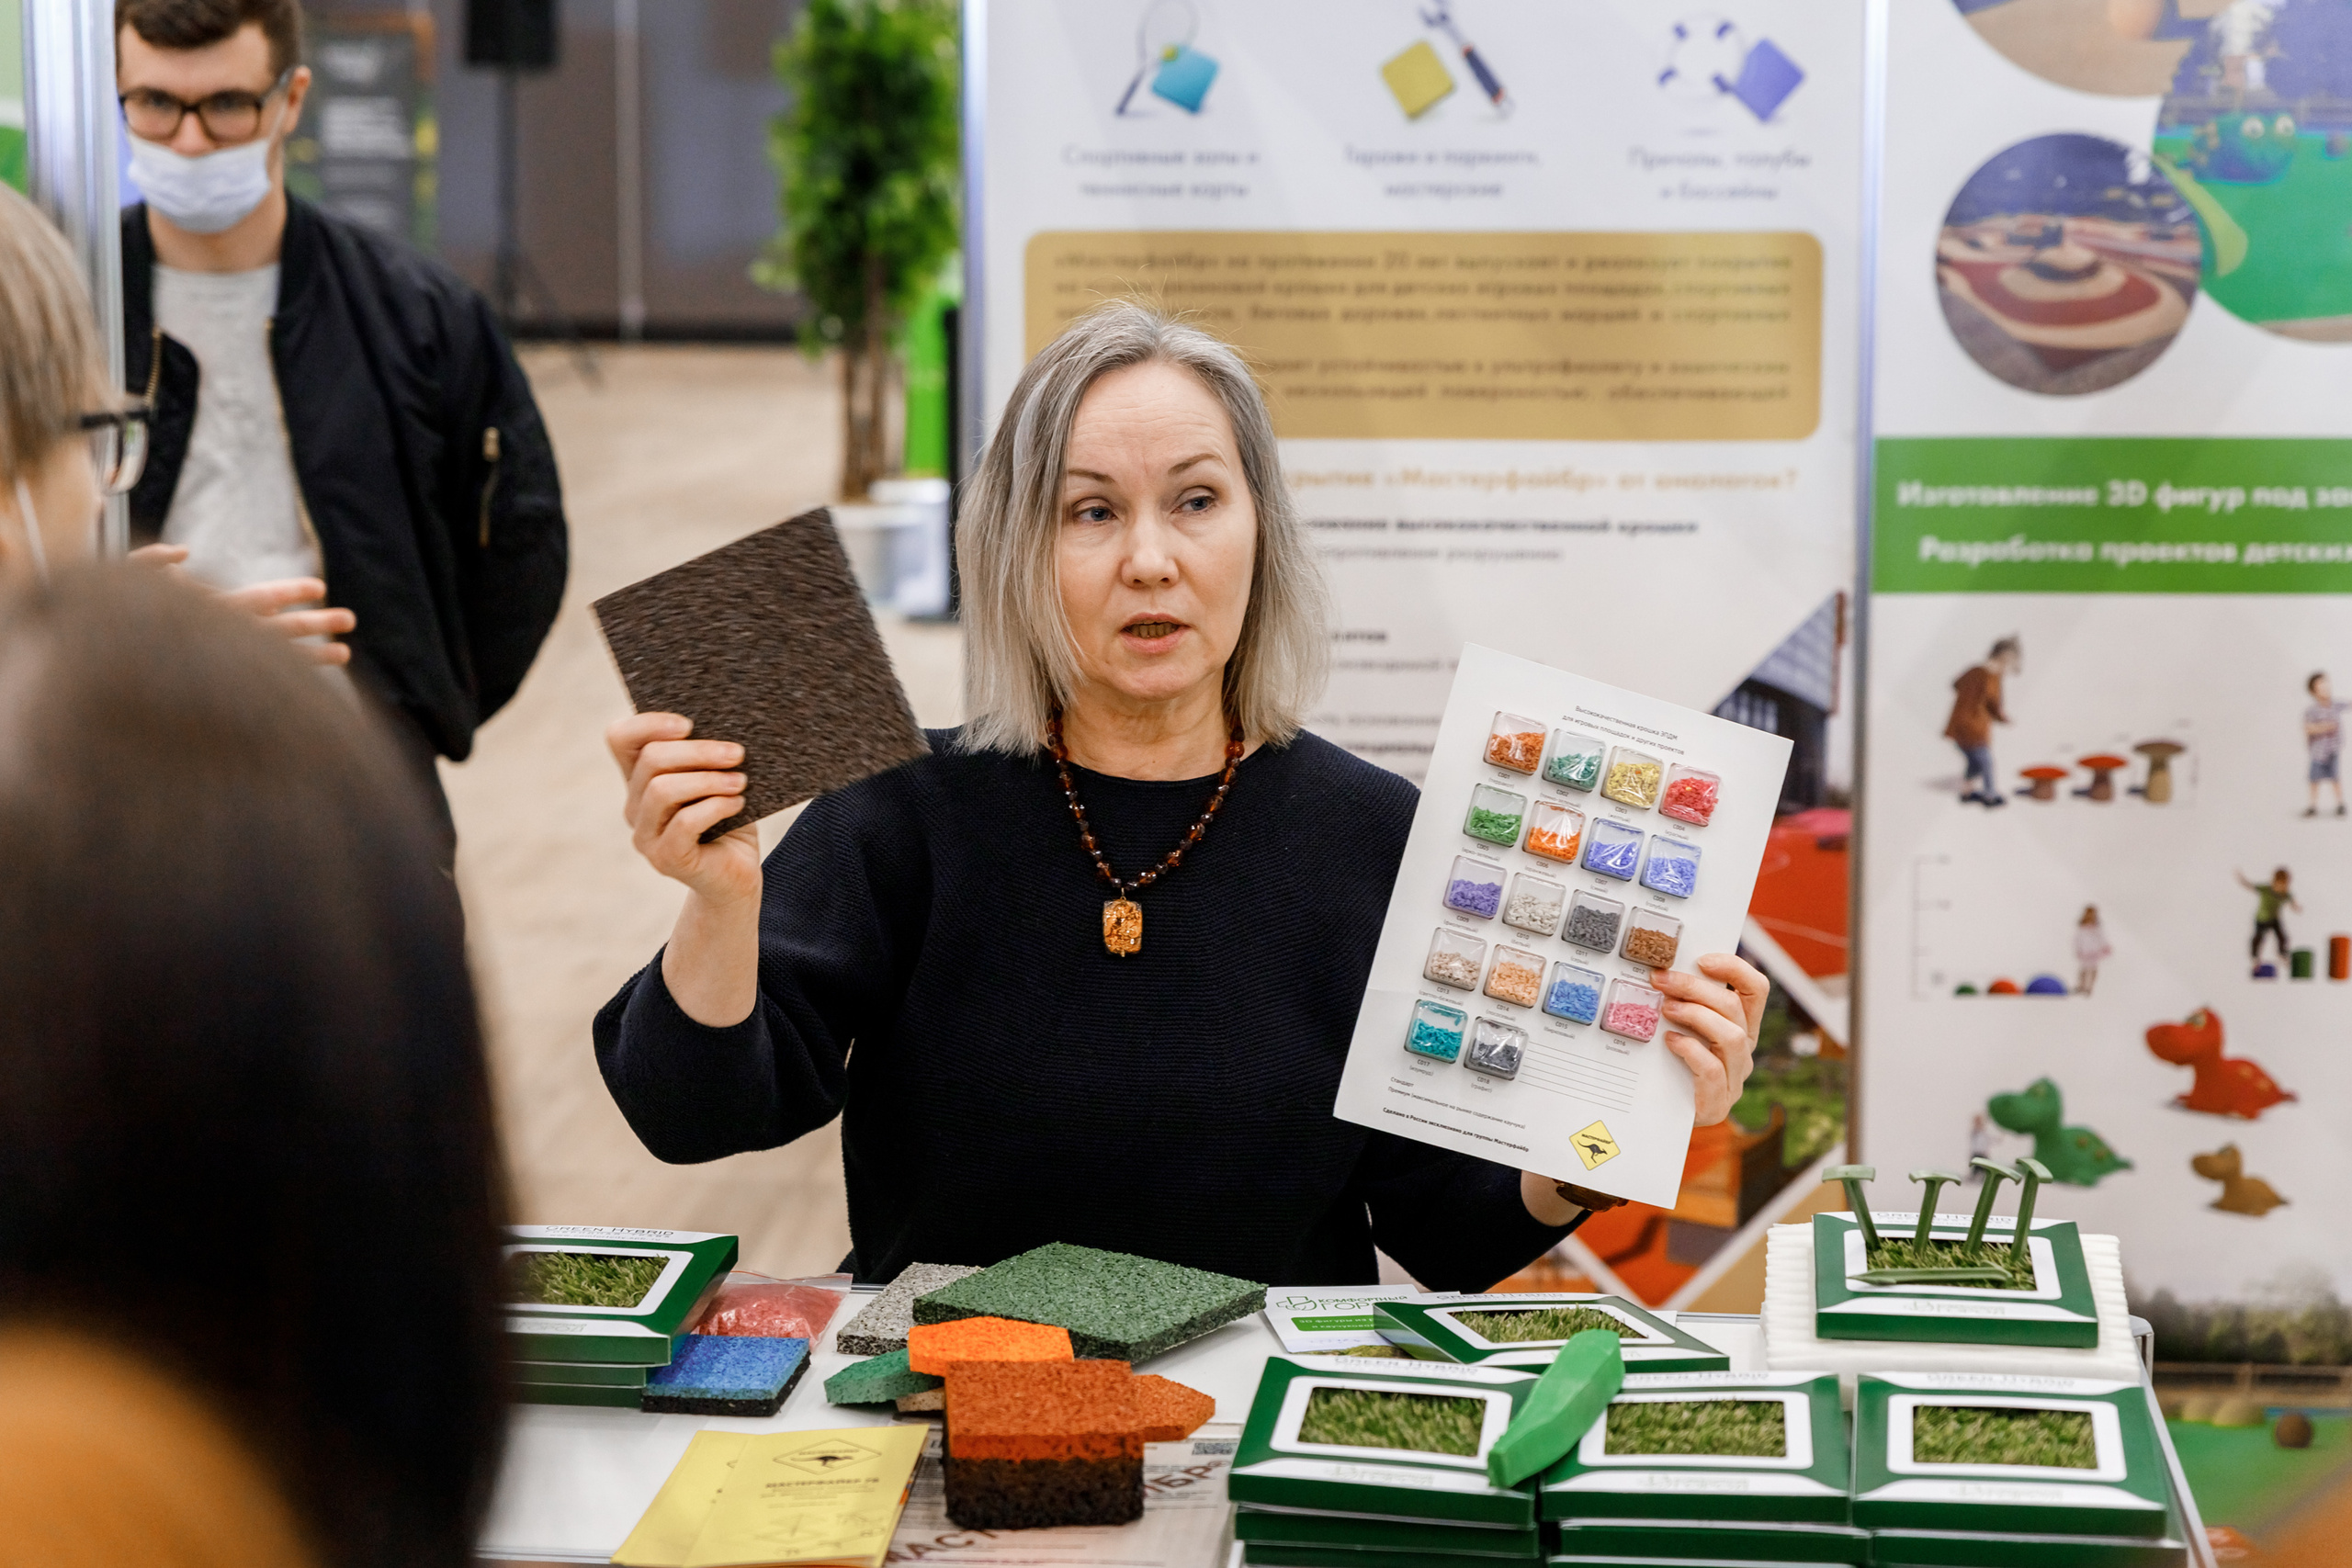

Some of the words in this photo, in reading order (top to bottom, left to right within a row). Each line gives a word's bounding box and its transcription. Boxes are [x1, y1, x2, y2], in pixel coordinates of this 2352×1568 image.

[1896, 480, 2098, 507] Изготовление
[2107, 479, 2147, 506] 3D
[2154, 482, 2245, 513] фигур
[2252, 486, 2309, 510] под
[1919, 534, 2093, 570] Разработка
[2101, 542, 2237, 569] проектов
[1574, 718, 1599, 729] игровых
[1600, 726, 1629, 739] площадок
[1635, 738, 1656, 747] других
[1657, 743, 1684, 755] проектов
[1575, 705, 1635, 728] Высококачественная
[1636, 724, 1659, 735] крошка
[1660, 731, 1677, 740] ЭПДМ
[1390, 1077, 1413, 1088] Стандарт
[1387, 1086, 1410, 1097] Премиум
[1411, 1092, 1448, 1107] (максимальное
[1456, 1106, 1471, 1114] рынке
[1472, 1111, 1502, 1122] содержание
[1503, 1119, 1525, 1130] каучука)
[1382, 1107, 1405, 1118] Сделано
[1410, 1115, 1427, 1123] России
[1429, 1121, 1461, 1133] эксклюзивно
[1473, 1134, 1492, 1143] группы
[1494, 1138, 1528, 1152] Мастерфайбр
[612, 1227, 673, 1235] HYBRID
[1317, 1295, 1408, 1304] КОМФОРТНЫЙ
[1321, 1303, 1371, 1311] ГОР
